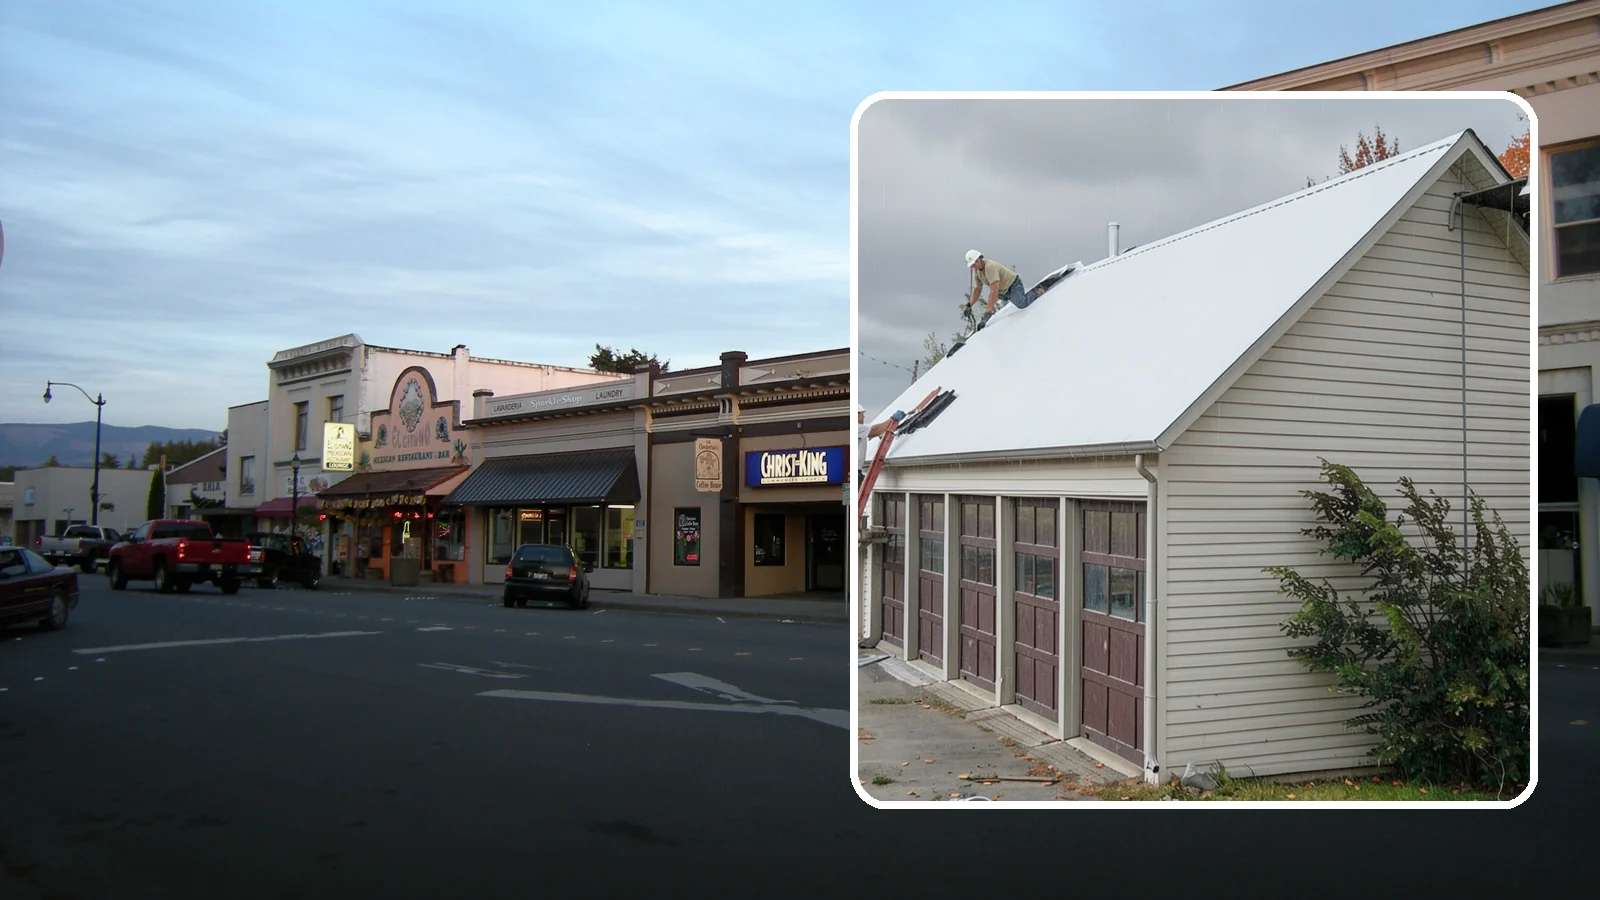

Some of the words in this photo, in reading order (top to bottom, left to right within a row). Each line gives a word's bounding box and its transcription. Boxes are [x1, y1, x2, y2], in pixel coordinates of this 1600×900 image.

[595, 389, 623, 400] LAUNDRY
[493, 402, 522, 412] LAVANDERIA
[531, 397, 560, 408] Sparkle
[562, 394, 582, 404] Shop
[392, 425, 401, 449] EL
[373, 454, 395, 463] MEXICAN
[397, 451, 433, 461] RESTAURANT
[438, 450, 450, 459] BAR
[760, 452, 797, 477] CHRIST
[799, 449, 827, 476] KING
[696, 480, 709, 488] Coffee
